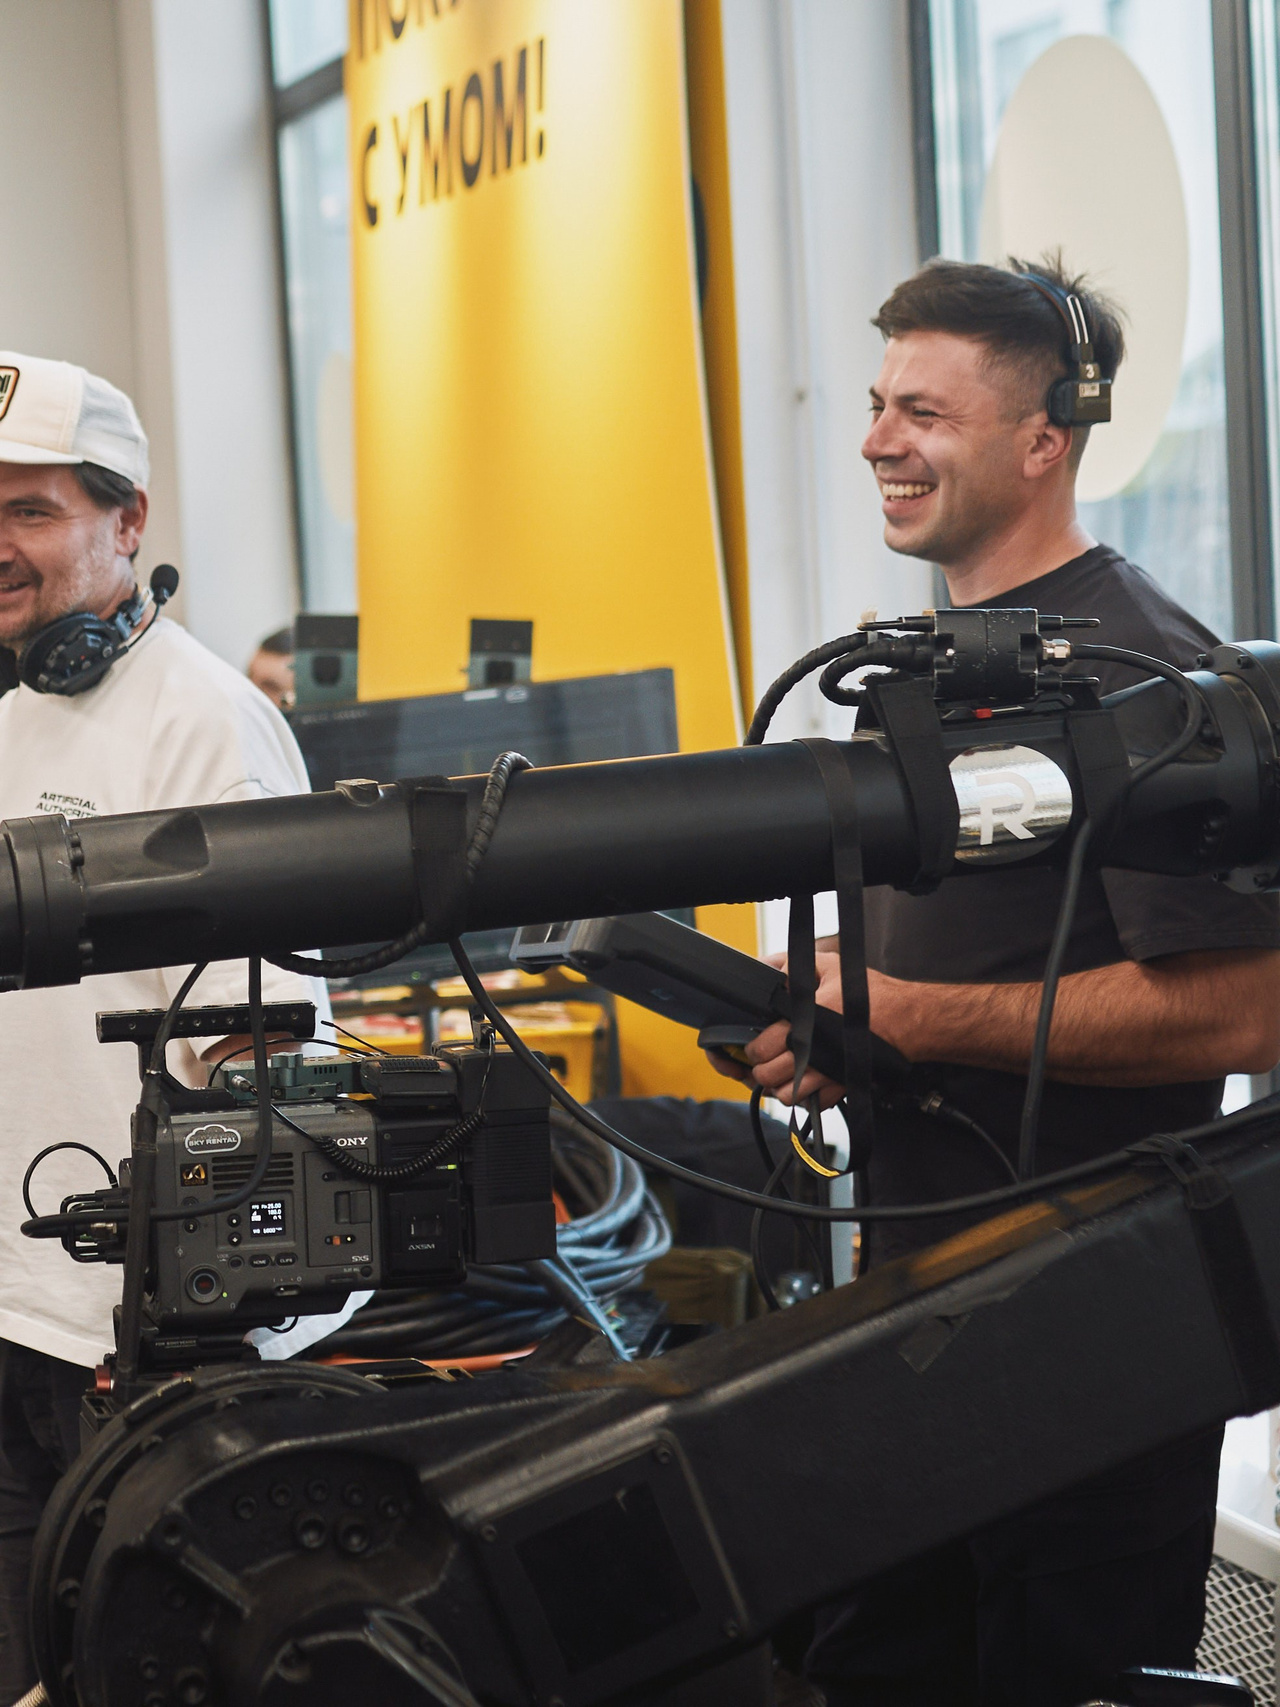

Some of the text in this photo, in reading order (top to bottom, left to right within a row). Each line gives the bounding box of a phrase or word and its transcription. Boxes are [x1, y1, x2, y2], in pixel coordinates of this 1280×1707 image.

[362, 38, 544, 227] С УМОМ!
[1086, 364, 1095, 379] 3
[189, 1136, 238, 1147] SKY RENTAL
[332, 1136, 369, 1147] ONY
[408, 1243, 436, 1251] AXSM
